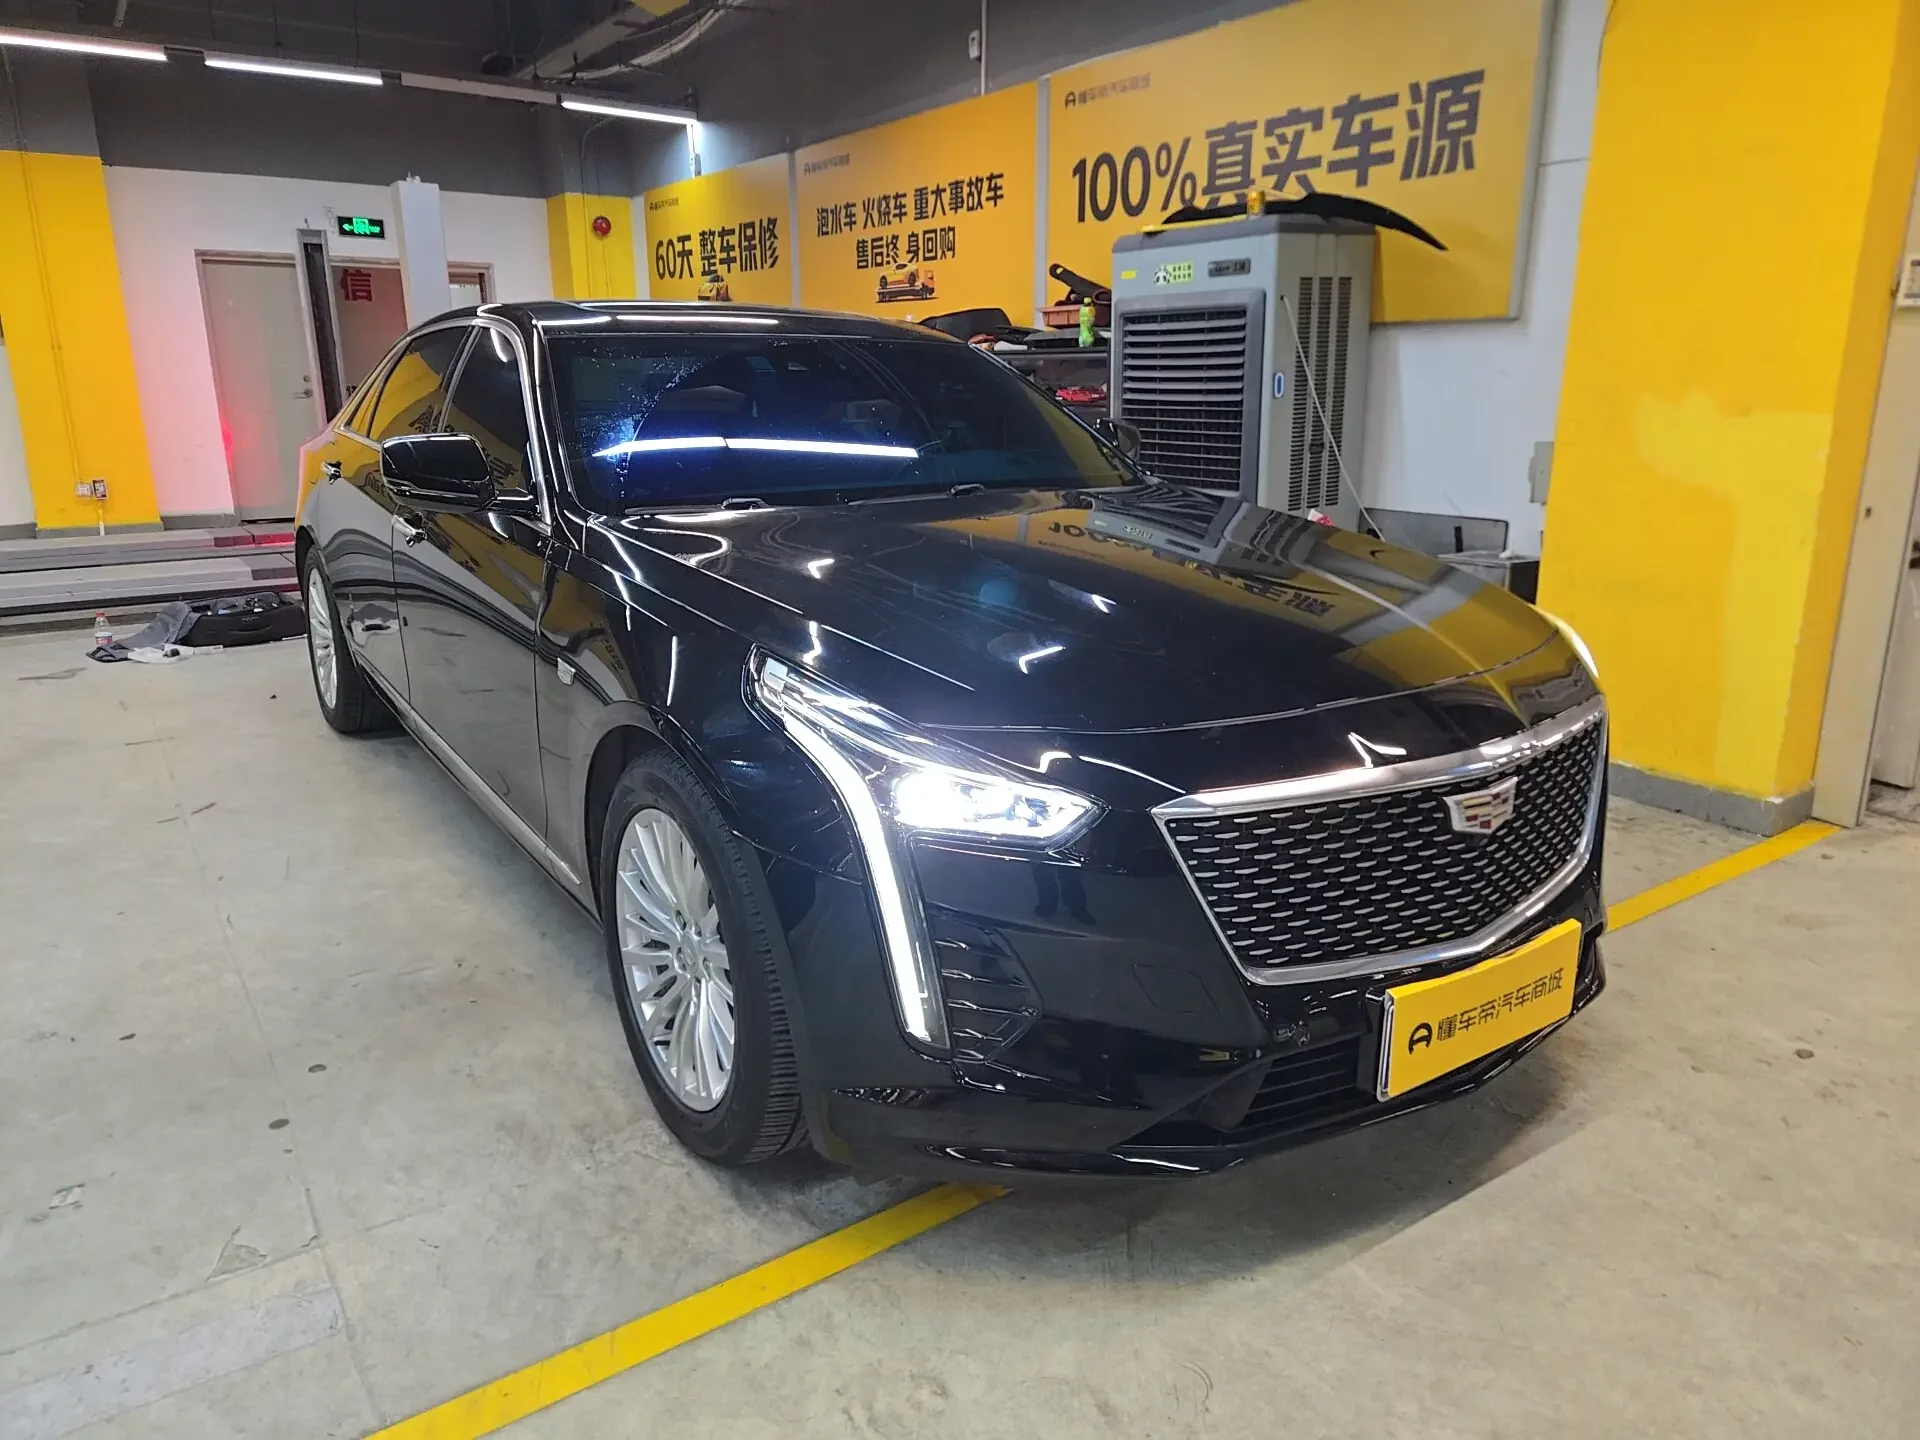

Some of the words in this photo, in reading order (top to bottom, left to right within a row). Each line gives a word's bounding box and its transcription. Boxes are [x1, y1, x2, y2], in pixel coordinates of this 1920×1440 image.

[1072, 69, 1485, 223] 100%真实车源
[816, 201, 857, 237] 泡水车
[862, 192, 907, 229] 火烧车
[913, 172, 1004, 222] 重大事故车
[655, 234, 694, 280] 60天
[699, 217, 779, 277] 整车保修
[856, 234, 900, 269] 售后终
[906, 226, 956, 263] 身回购
[340, 269, 372, 302] 信
[1437, 967, 1565, 1042] 懂车帝汽车商城
